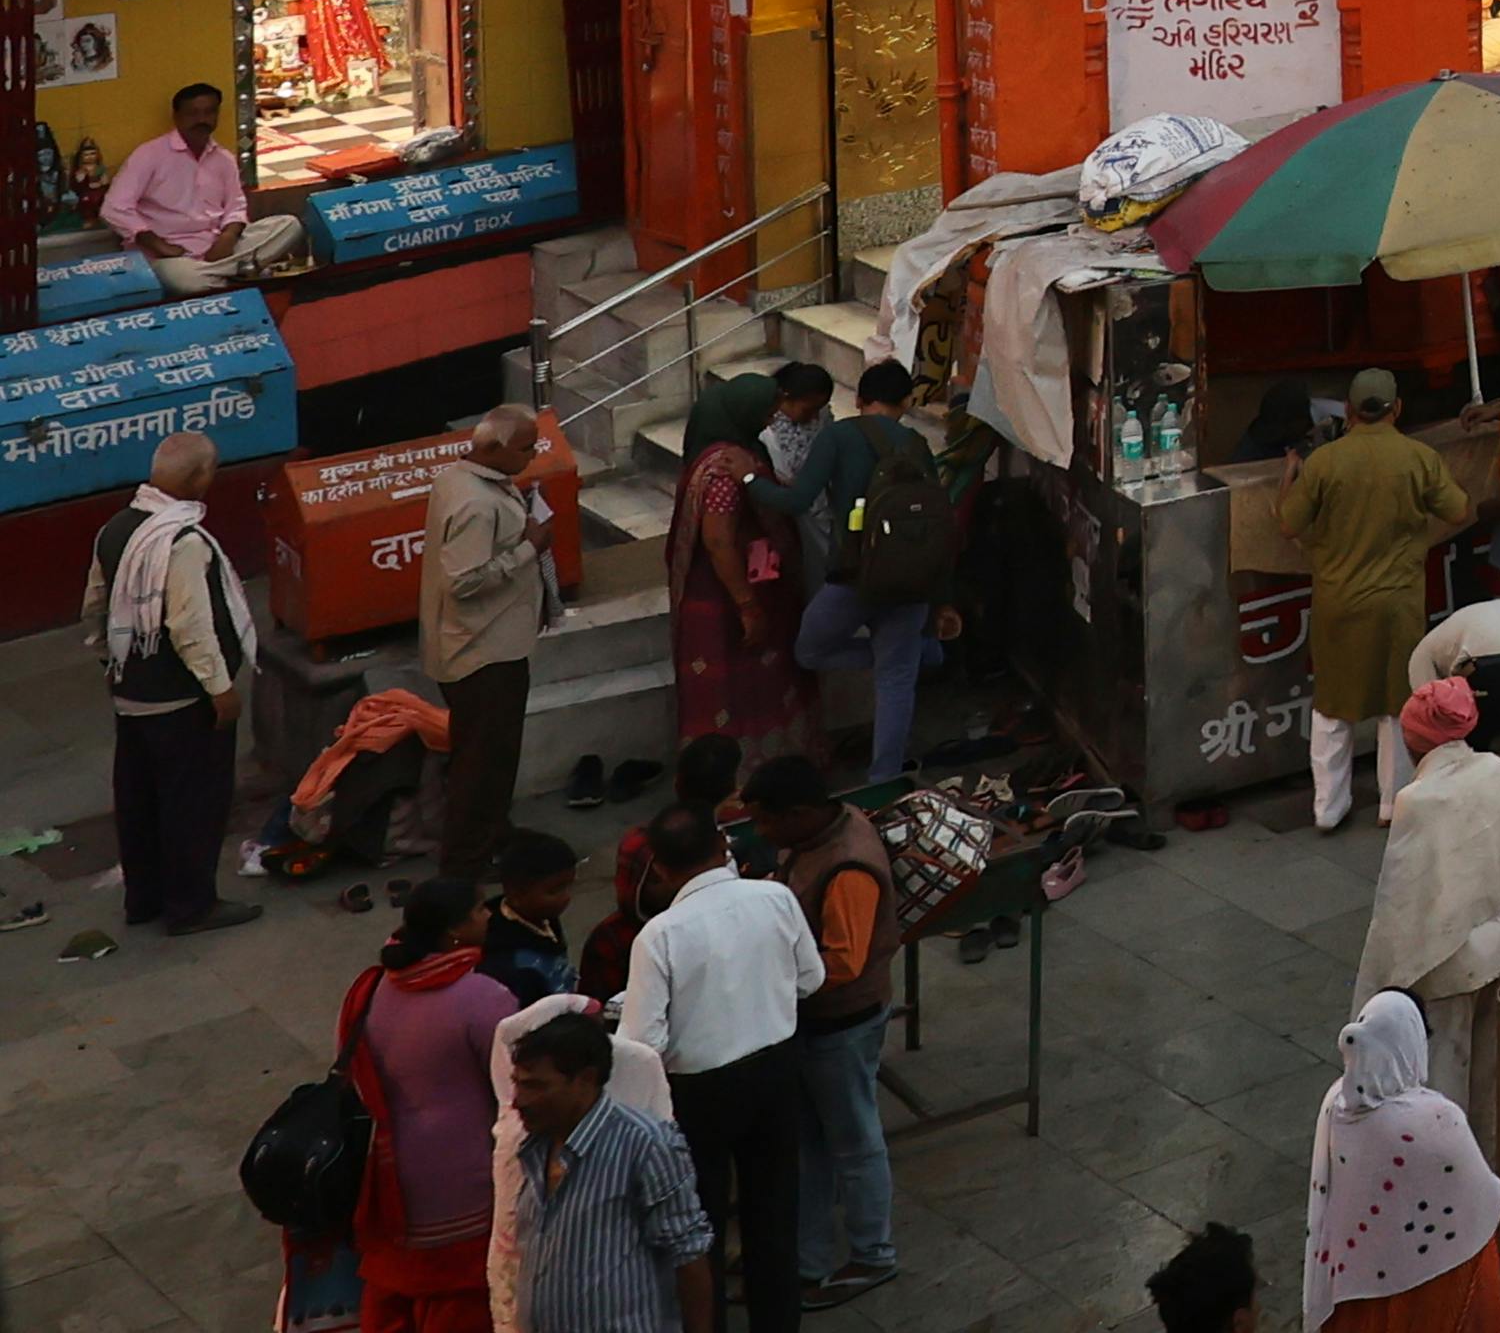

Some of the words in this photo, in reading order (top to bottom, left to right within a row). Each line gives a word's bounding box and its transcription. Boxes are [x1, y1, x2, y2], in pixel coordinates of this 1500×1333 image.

[1203, 17, 1295, 48] હરિચરણ
[1188, 48, 1246, 81] મંદિર
[384, 222, 464, 253] CHARITY
[474, 211, 513, 233] BOX
[408, 204, 451, 223] दान
[3, 331, 38, 355] श्री
[115, 312, 156, 332] मठ
[164, 296, 236, 321] मन्दिर
[146, 345, 209, 370] गायत्री
[208, 333, 276, 356] मन्दिर
[56, 383, 122, 410] दान
[155, 362, 216, 385] पात्र
[2, 407, 177, 463] मनोकामना
[397, 446, 436, 465] गंगा
[436, 439, 473, 457] मात
[1199, 700, 1258, 764] श्री
